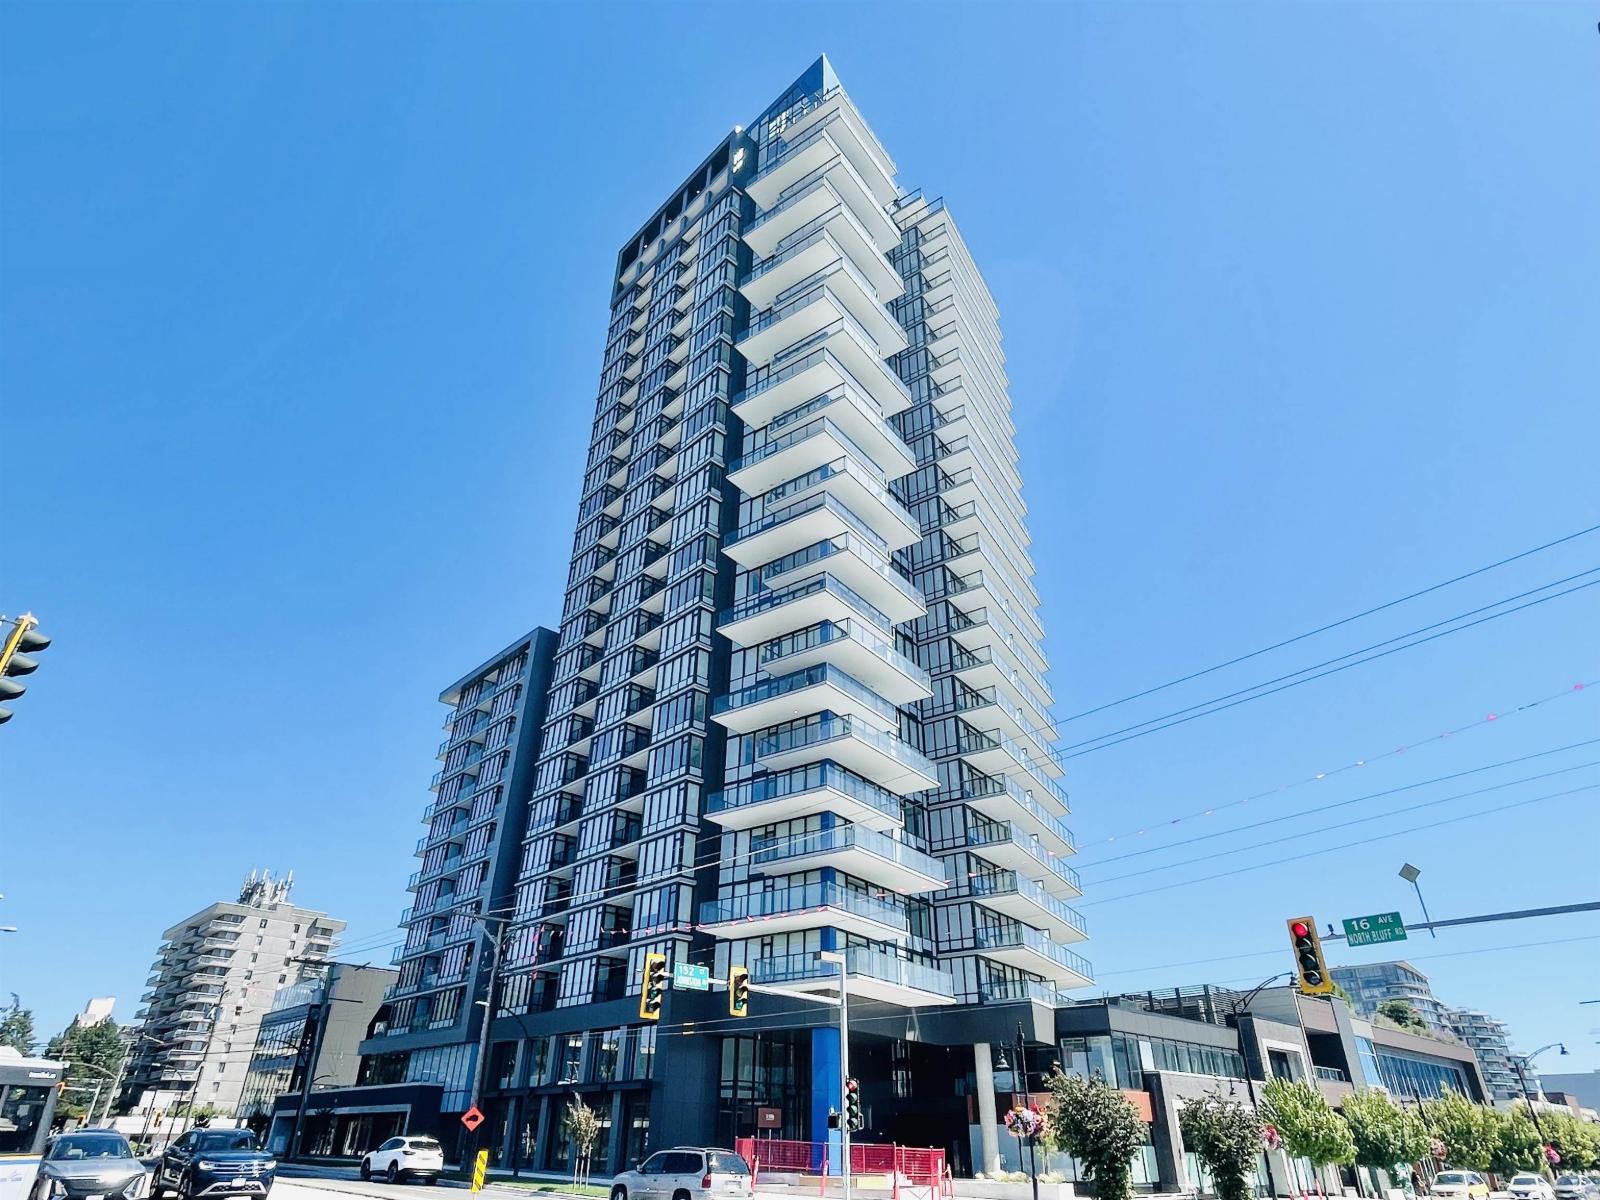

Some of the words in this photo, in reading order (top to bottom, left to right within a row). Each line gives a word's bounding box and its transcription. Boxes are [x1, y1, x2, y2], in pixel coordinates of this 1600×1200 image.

[1351, 919, 1370, 931] 16
[1378, 915, 1393, 924] AVE
[1348, 931, 1371, 945] NORTH
[1371, 929, 1392, 942] BLUFF
[1394, 927, 1404, 935] RD
[679, 965, 695, 977] 152
